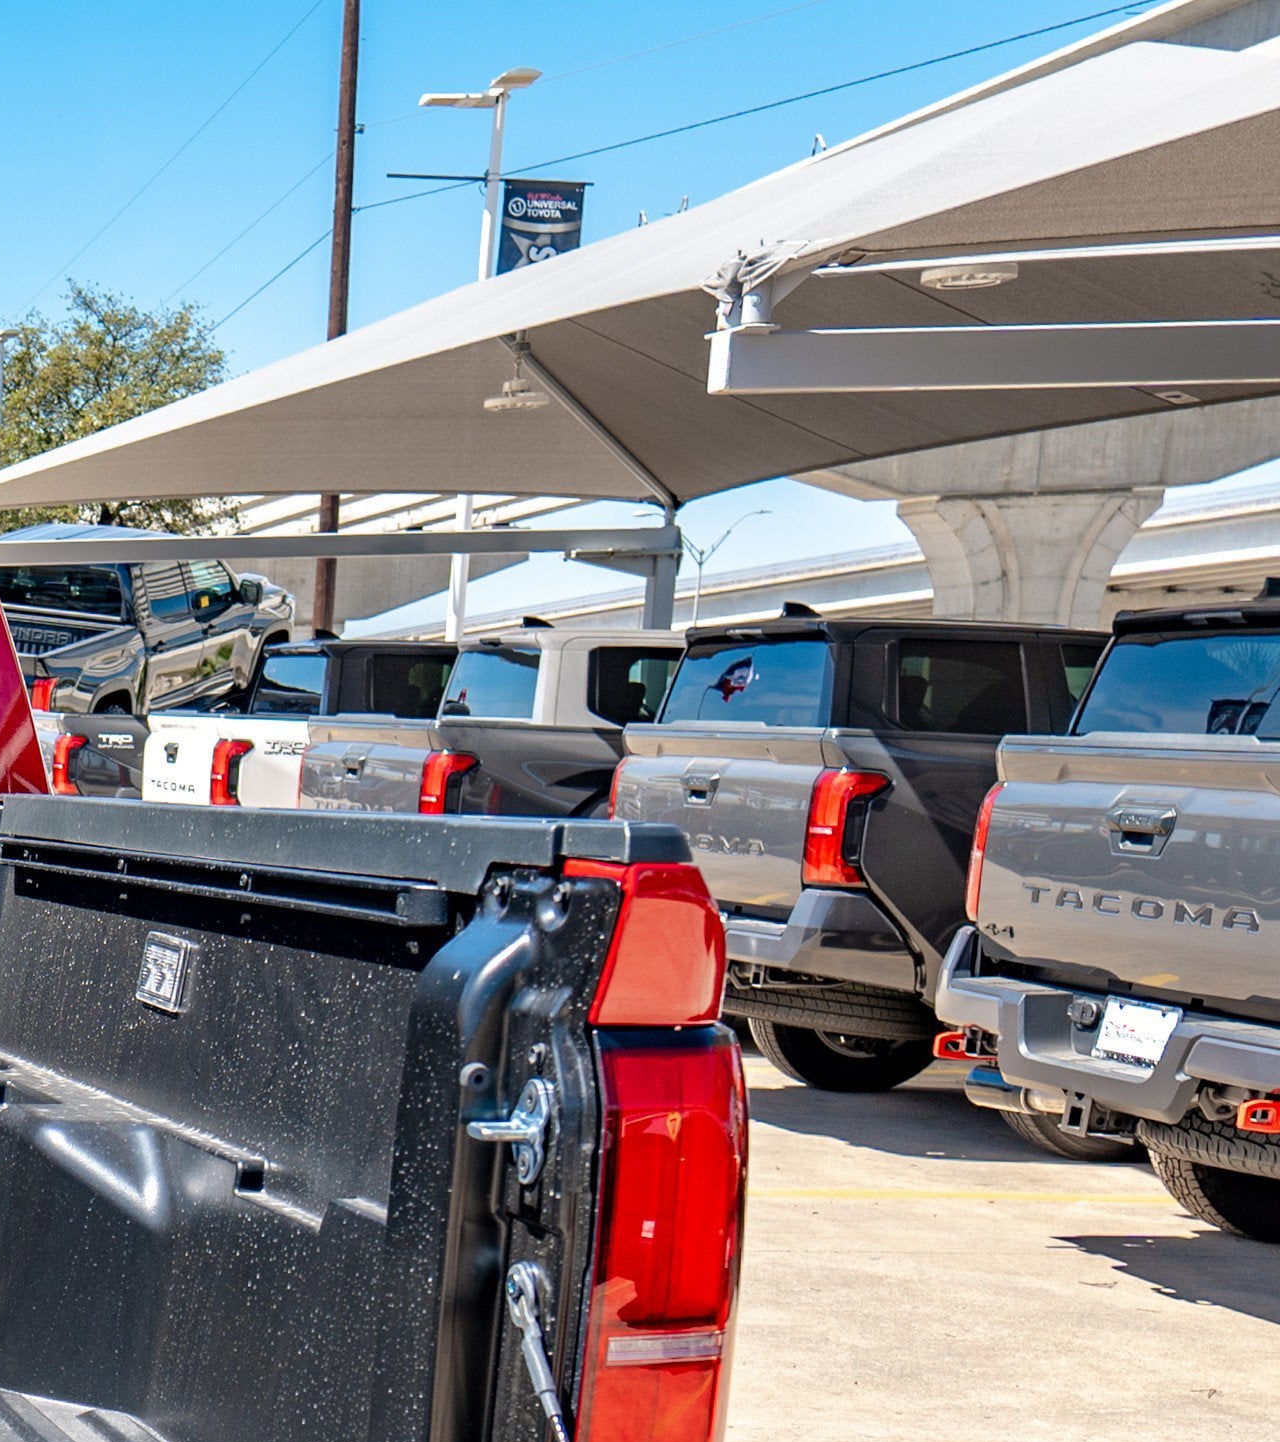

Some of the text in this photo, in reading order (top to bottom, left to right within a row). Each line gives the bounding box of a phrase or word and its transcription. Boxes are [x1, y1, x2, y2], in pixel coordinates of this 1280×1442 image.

[526, 200, 578, 210] UNIVERSAL
[526, 209, 561, 218] TOYOTA
[97, 733, 134, 744] TRD
[684, 832, 765, 857] OMA
[1022, 882, 1262, 934] TACOMA
